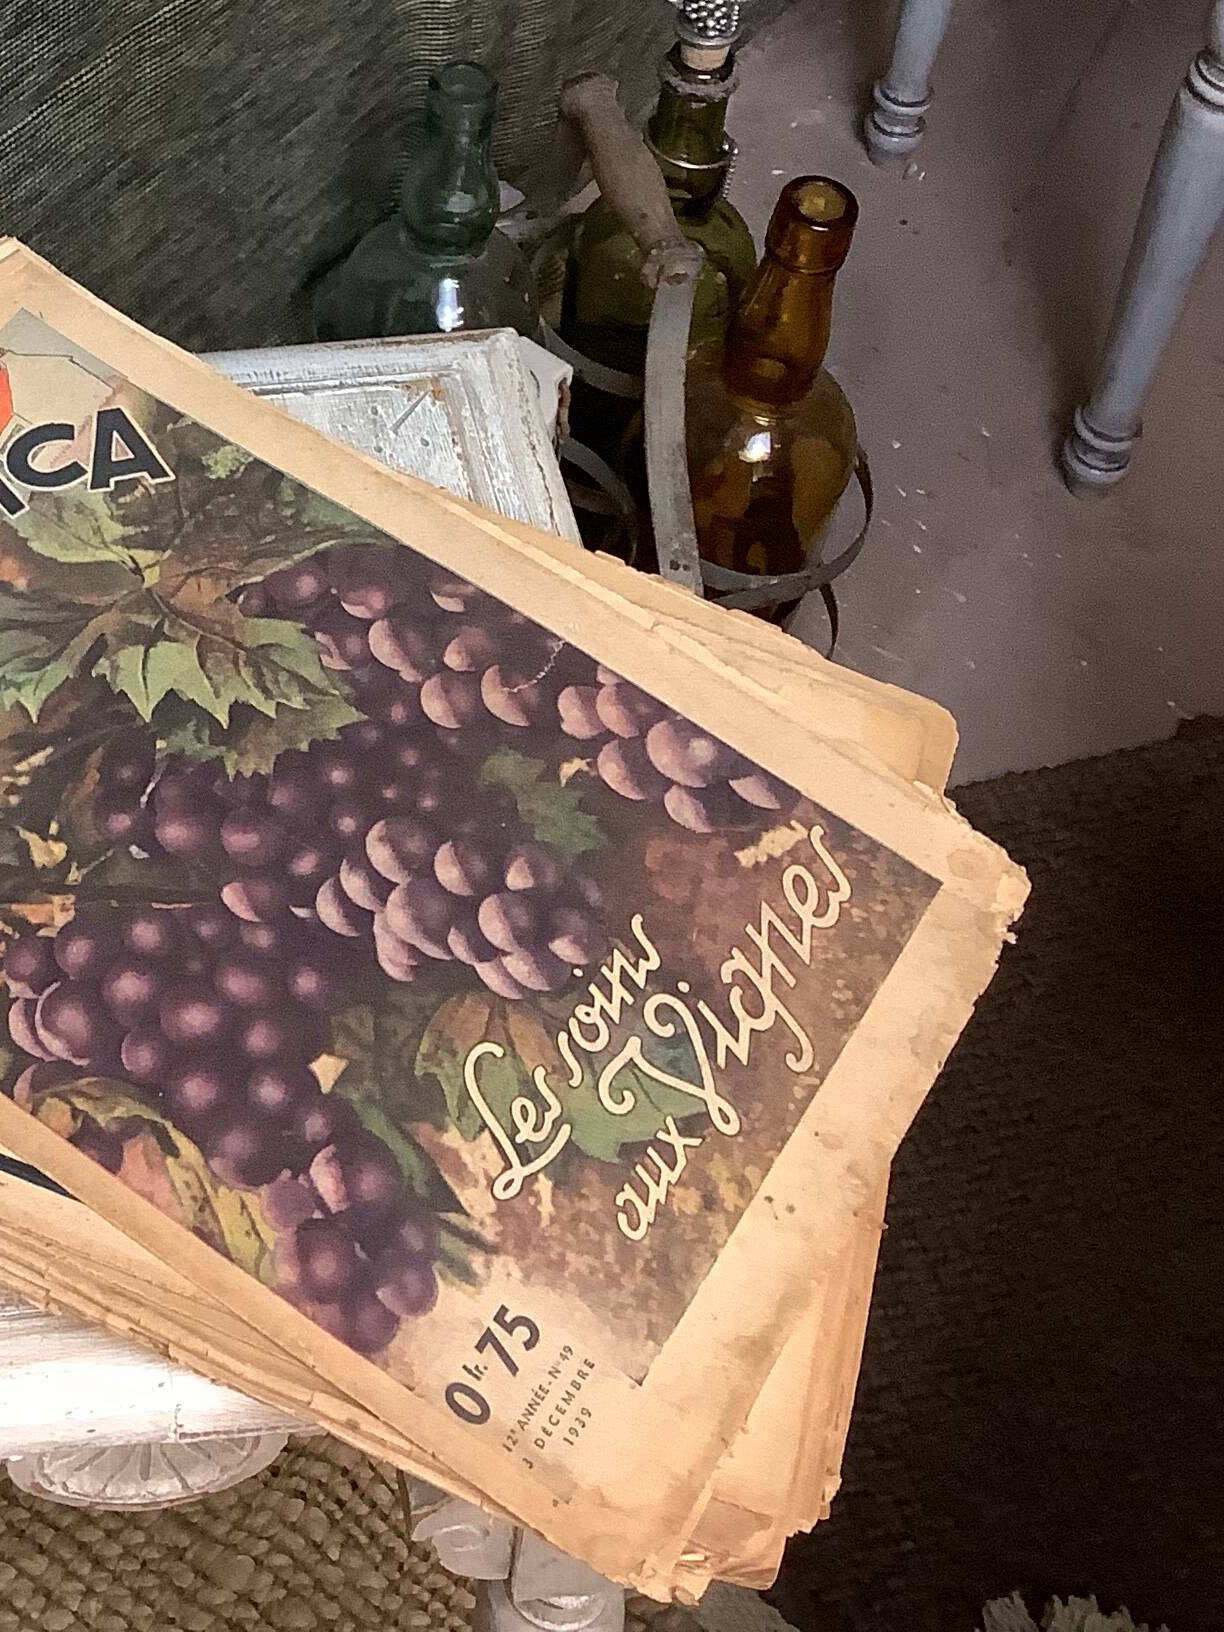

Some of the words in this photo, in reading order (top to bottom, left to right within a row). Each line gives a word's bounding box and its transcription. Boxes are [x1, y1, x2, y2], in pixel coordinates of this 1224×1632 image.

[597, 824, 852, 1136] Vignes
[464, 1041, 571, 1200] Les
[558, 914, 662, 1087] soins
[615, 1115, 703, 1241] aux
[445, 1382, 491, 1425] 0
[474, 1304, 540, 1377] 75
[559, 1345, 574, 1361] 49
[522, 1457, 534, 1469] 3
[563, 1407, 592, 1446] 1939
